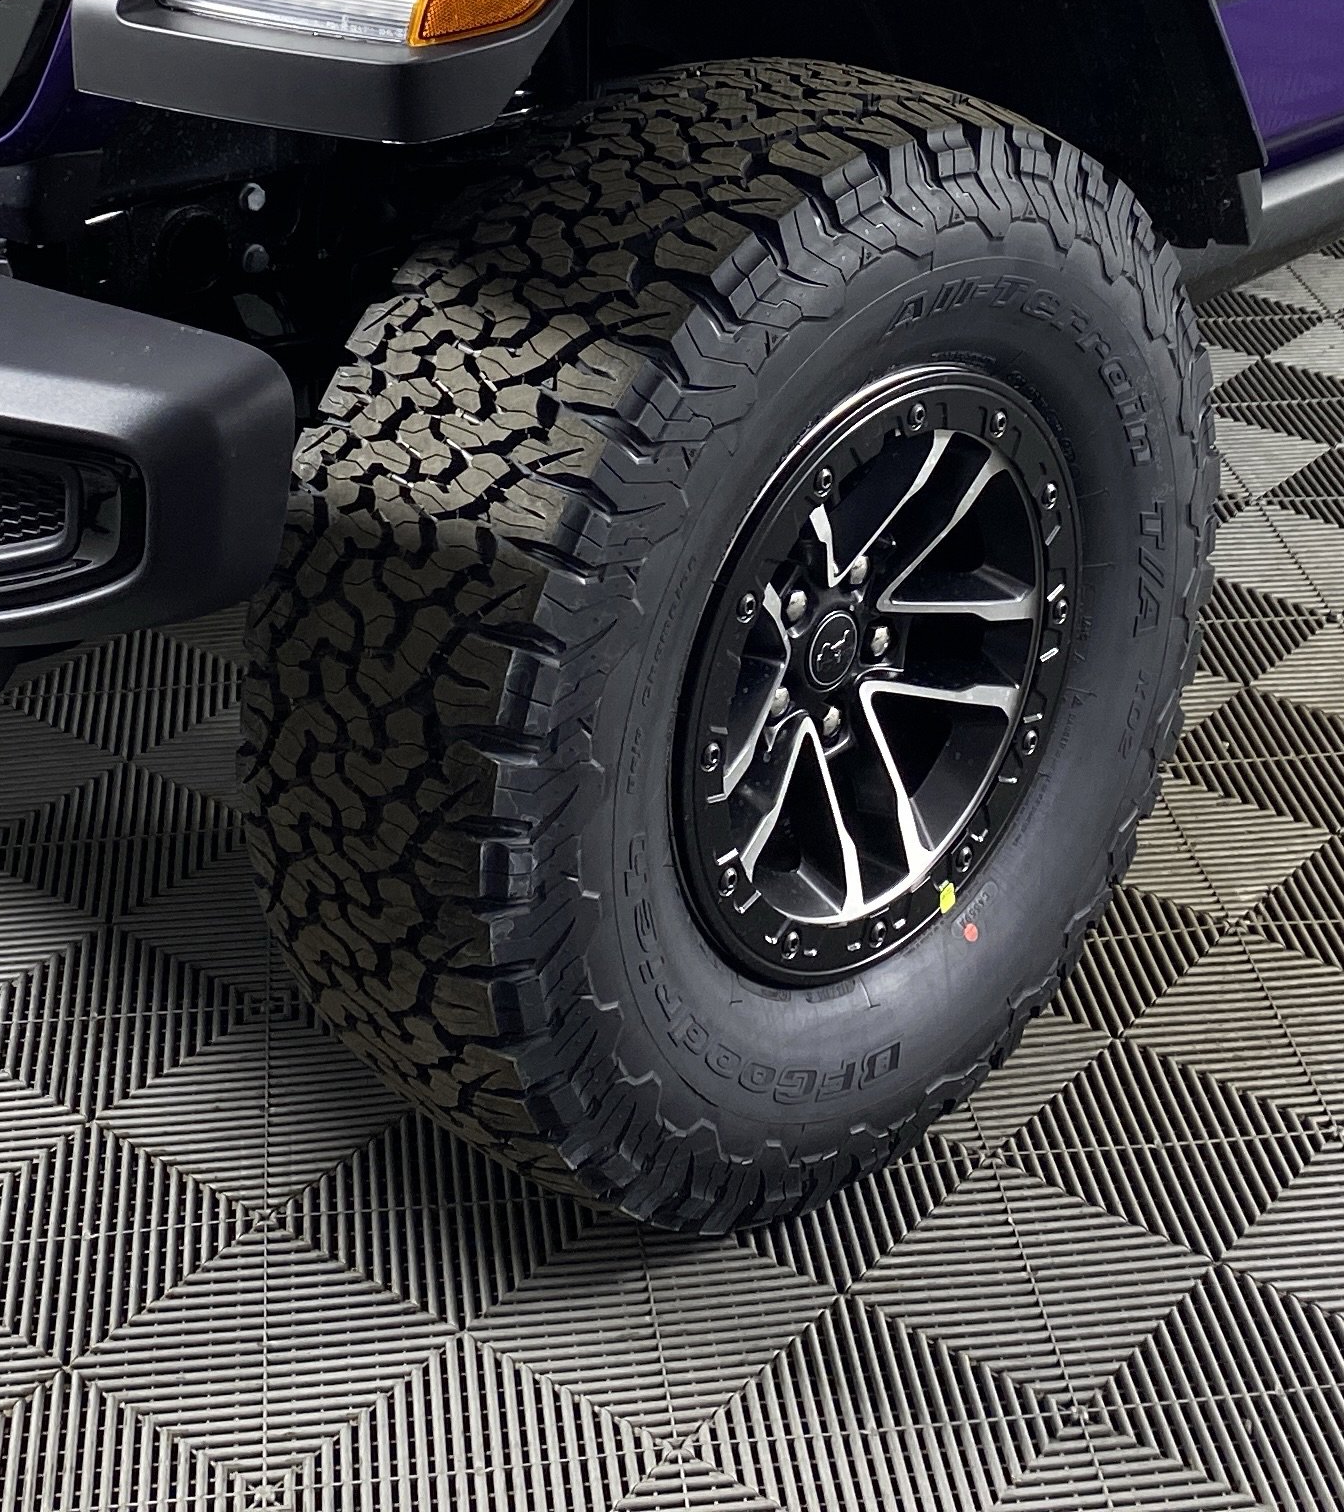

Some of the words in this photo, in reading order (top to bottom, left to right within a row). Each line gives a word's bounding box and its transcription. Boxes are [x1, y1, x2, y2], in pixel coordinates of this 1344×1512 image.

[882, 273, 1155, 468] All-Terrain
[1132, 500, 1167, 639] T/A
[1117, 668, 1152, 761] KO2
[623, 833, 905, 1106] BFGoodrich
